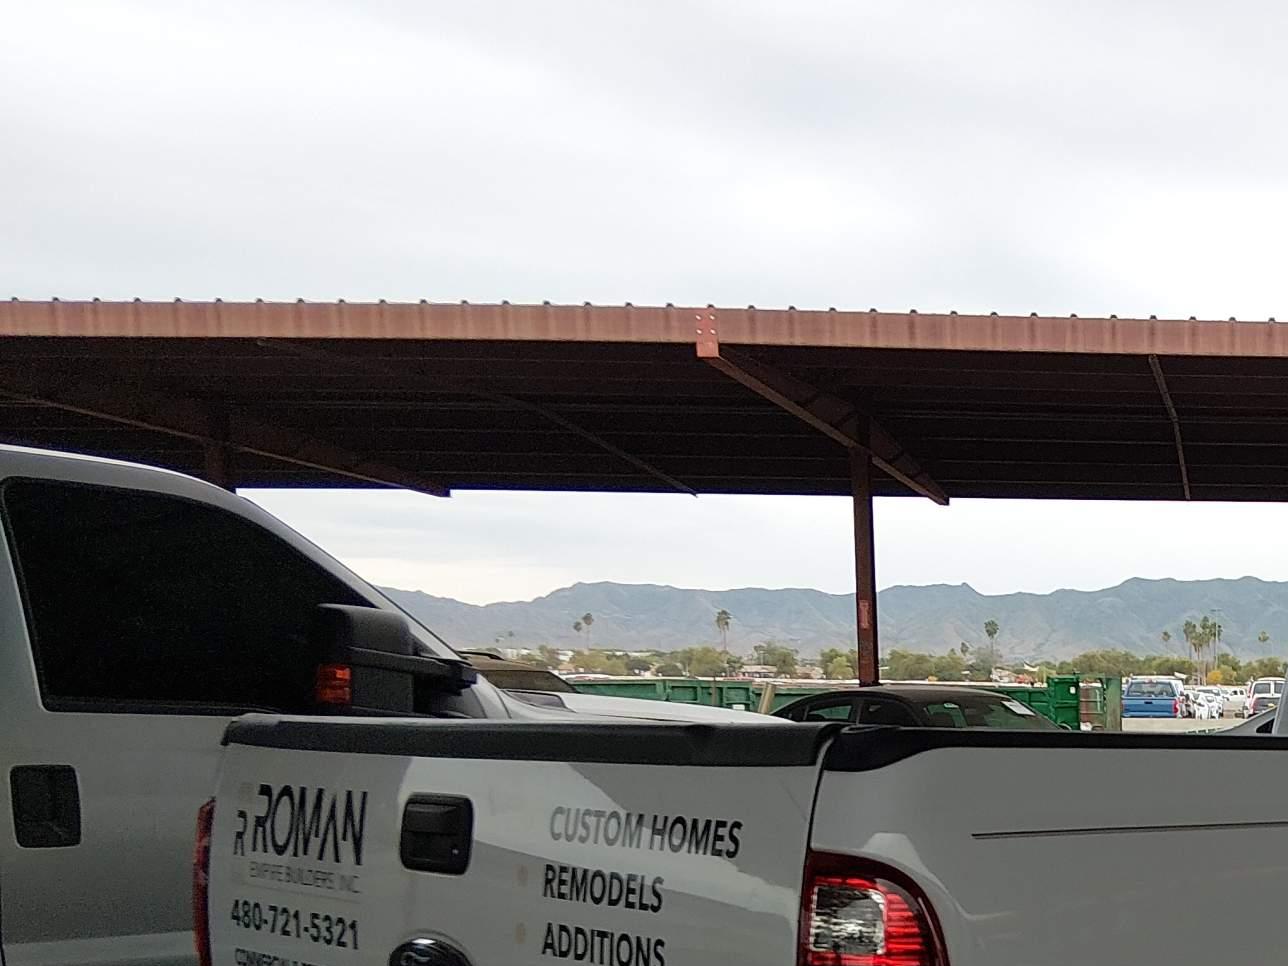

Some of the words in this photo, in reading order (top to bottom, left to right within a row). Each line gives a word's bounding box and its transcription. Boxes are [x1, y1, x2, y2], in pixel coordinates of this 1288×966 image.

[251, 783, 368, 866] ROMAN
[550, 806, 646, 848] CUSTOM
[649, 814, 743, 859] HOMES
[543, 864, 664, 913] REMODELS
[230, 899, 360, 950] 480-721-5321
